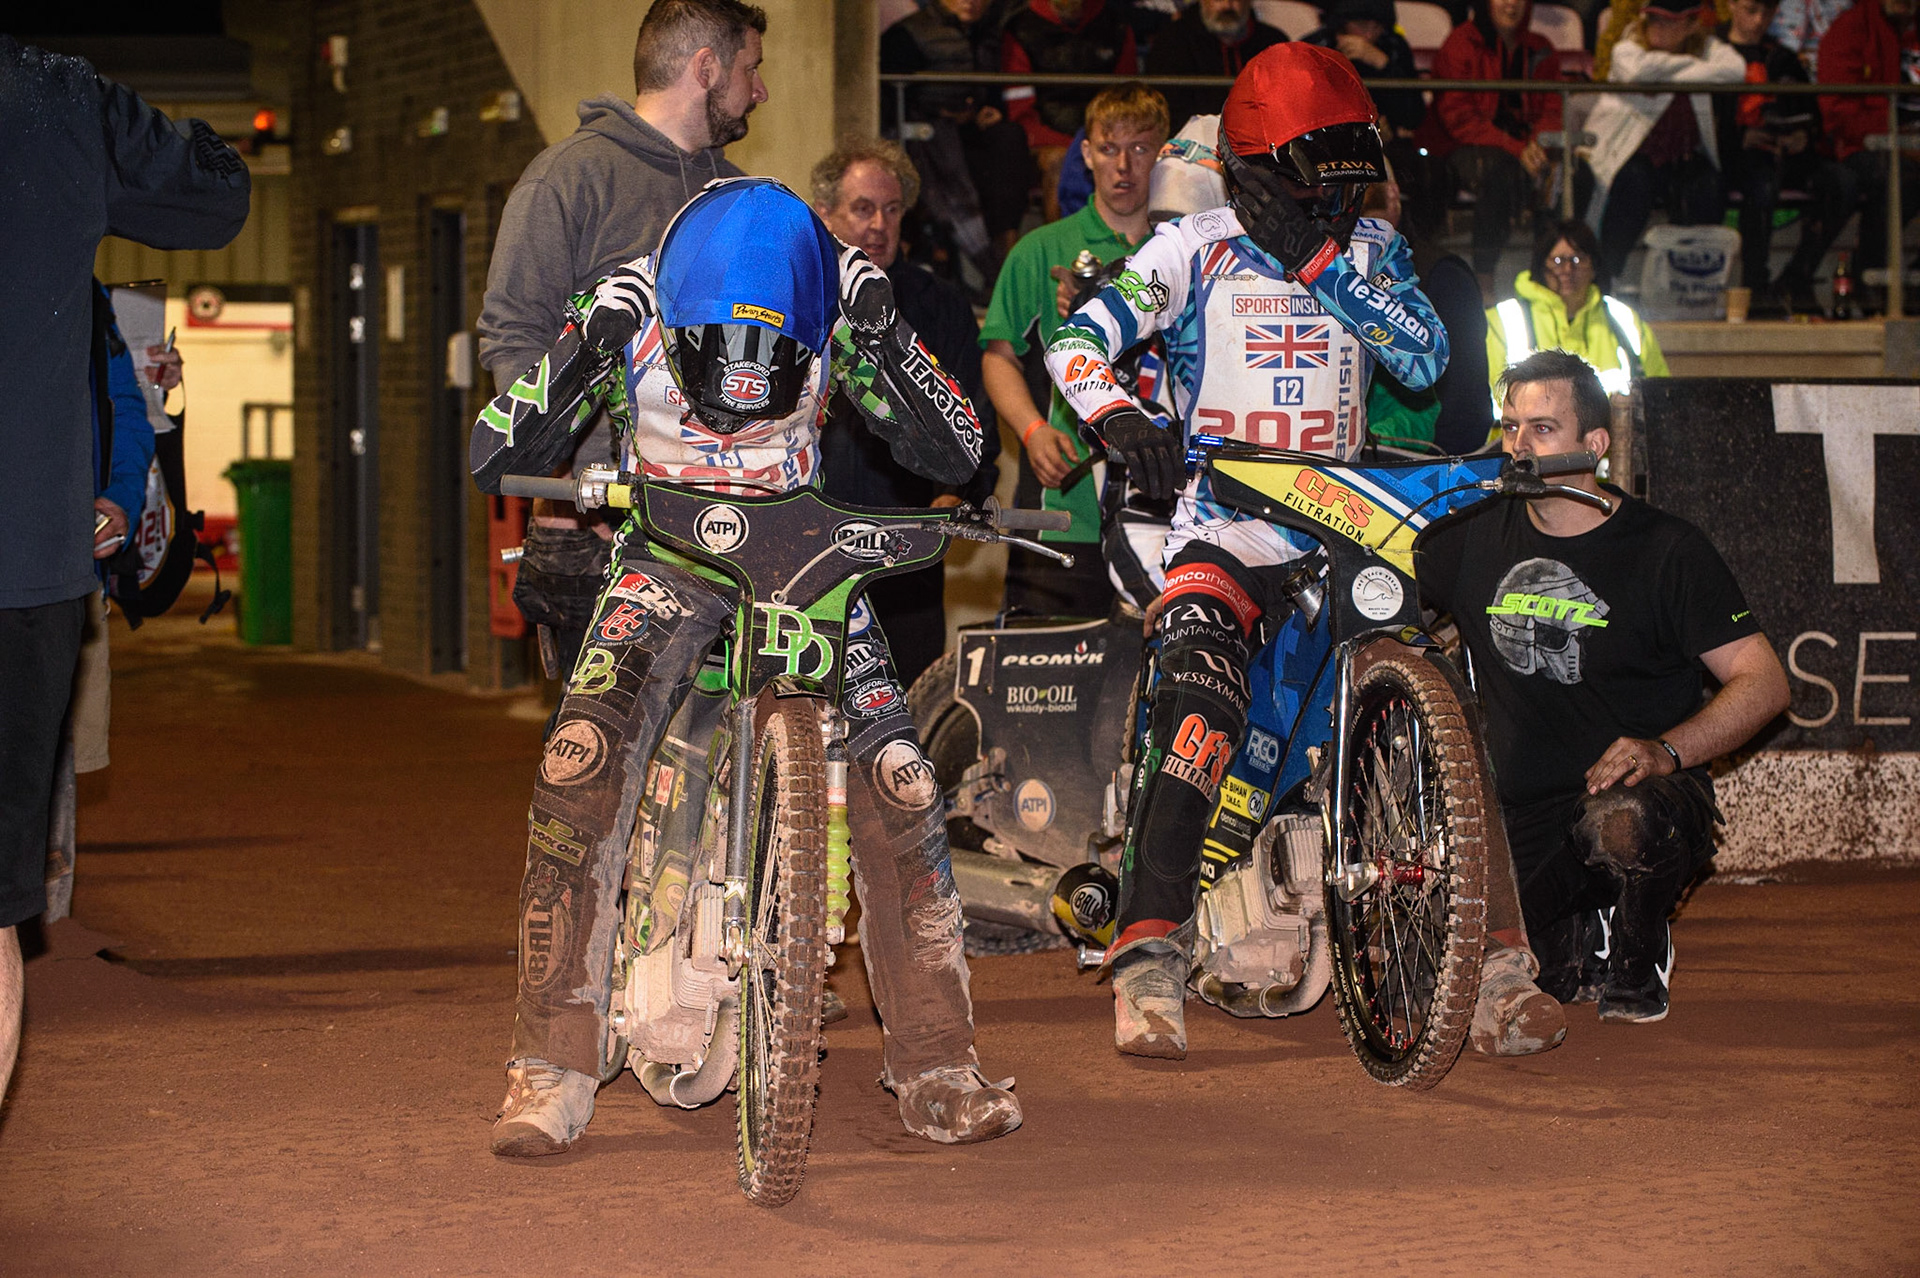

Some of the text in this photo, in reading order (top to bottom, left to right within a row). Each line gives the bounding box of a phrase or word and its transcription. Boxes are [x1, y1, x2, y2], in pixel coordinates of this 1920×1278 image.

[1317, 161, 1376, 172] STAVA
[1235, 297, 1290, 314] SPORTS
[723, 361, 770, 378] STAKEFORD
[723, 375, 766, 395] STS
[1277, 379, 1301, 403] 12
[719, 394, 770, 410] TYRE SERVICES
[1334, 346, 1352, 460] BRITISH
[1294, 468, 1374, 528] CFS
[703, 521, 737, 536] ATPI
[1284, 492, 1365, 542] FILTRATION
[1486, 593, 1609, 628] SCOTT
[966, 647, 986, 687] 1
[856, 684, 895, 710] STS
[550, 738, 591, 764] ATPI
[1172, 713, 1232, 785] CFS
[1163, 756, 1217, 800] FILTRATIO
[1020, 797, 1048, 813] ATPI
[556, 840, 582, 860] OIL
